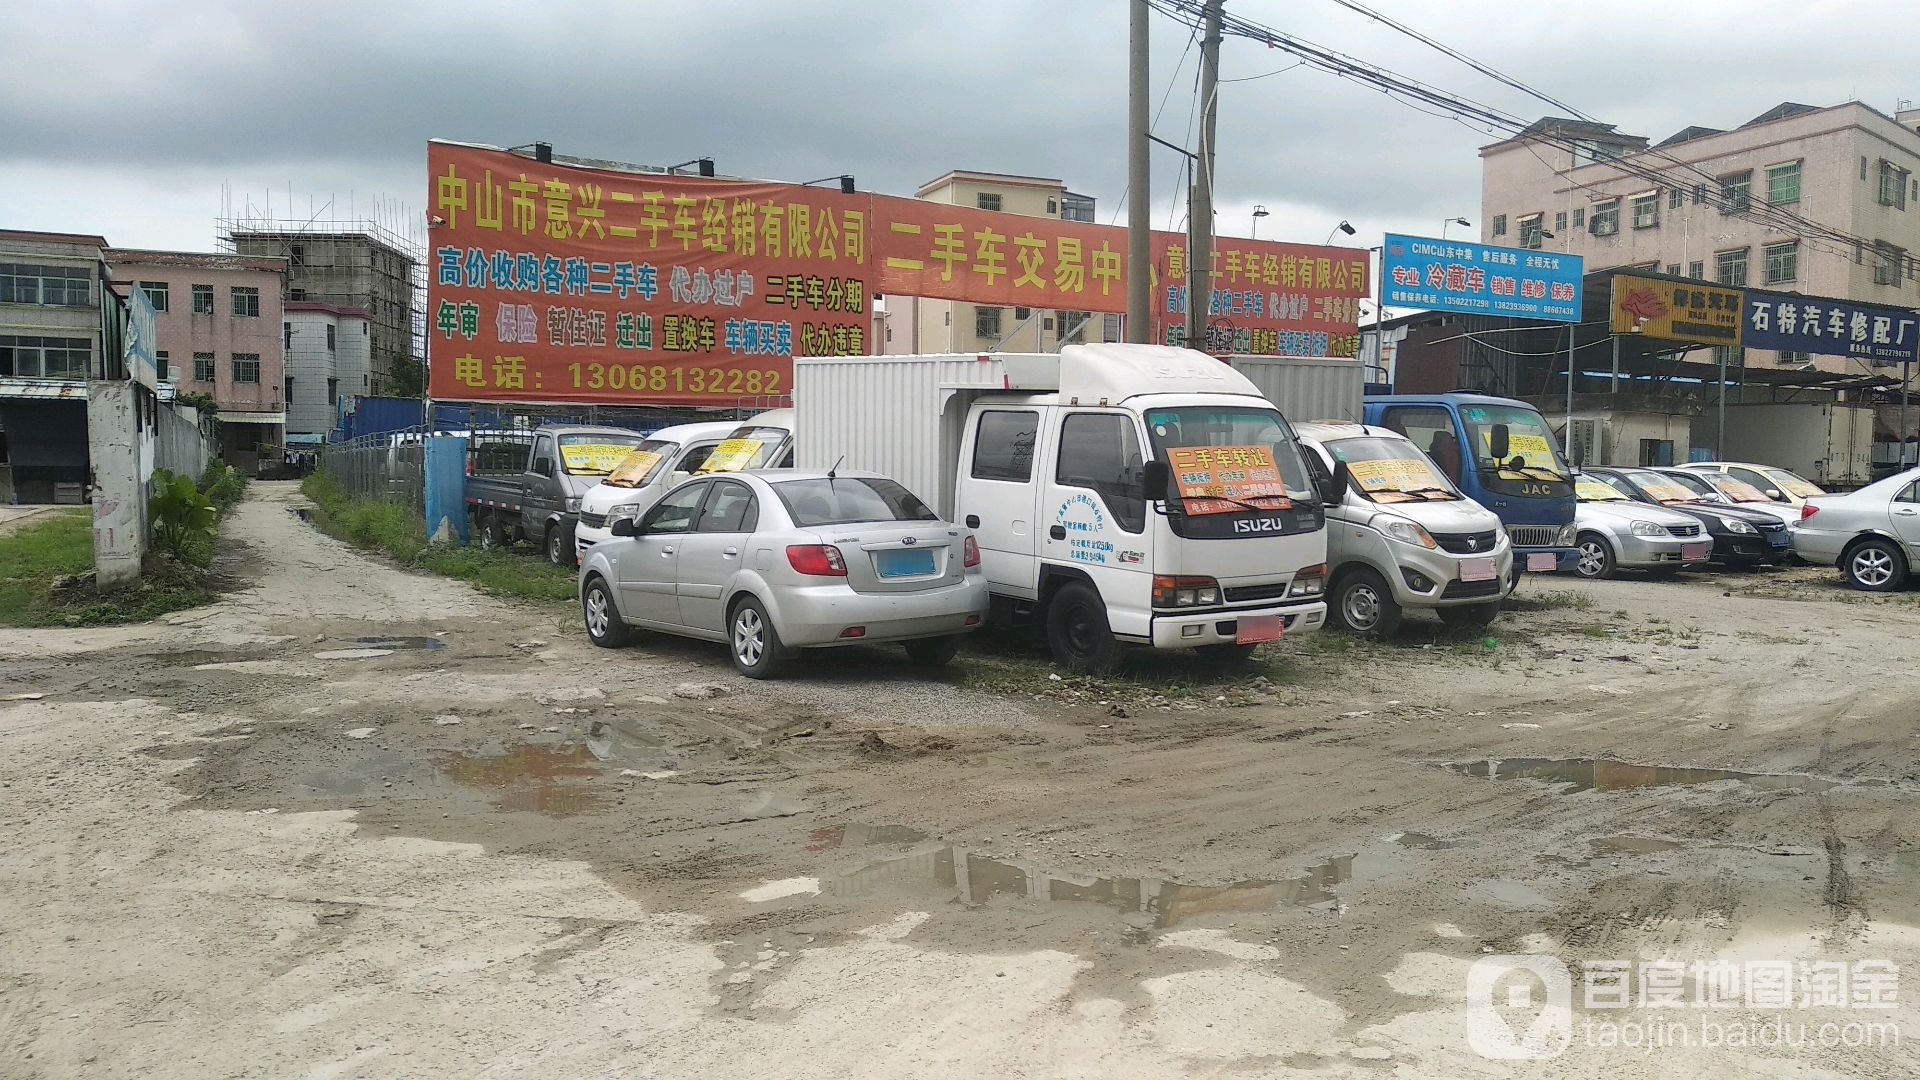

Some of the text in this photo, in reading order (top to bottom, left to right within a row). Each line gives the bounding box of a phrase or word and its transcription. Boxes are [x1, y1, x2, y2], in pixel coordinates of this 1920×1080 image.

[437, 163, 865, 265] 中山市意兴二手车经销有限公司
[886, 222, 1158, 296] 二手车交易中
[1167, 243, 1365, 293] 意二手车经销有限公司
[1412, 242, 1559, 270] CIMC山东中集 售后服务 全程无忧
[437, 245, 863, 314] 高价收购各种二手车 代办过户 二手车分期
[1392, 263, 1575, 301] 专业 冷藏车 销售 维修 保养
[1269, 292, 1309, 321] 代办过户
[1751, 301, 1915, 347] 石特汽车修配厂
[437, 298, 863, 356] 年审 保险 暂住证 迁出 置换车 车辆买卖 代办违章
[568, 361, 780, 394] 13068132282
[1176, 448, 1269, 469] 二手车转让
[1521, 483, 1551, 495] JAC
[902, 537, 917, 545] KIA
[1233, 517, 1282, 533] ISUZU
